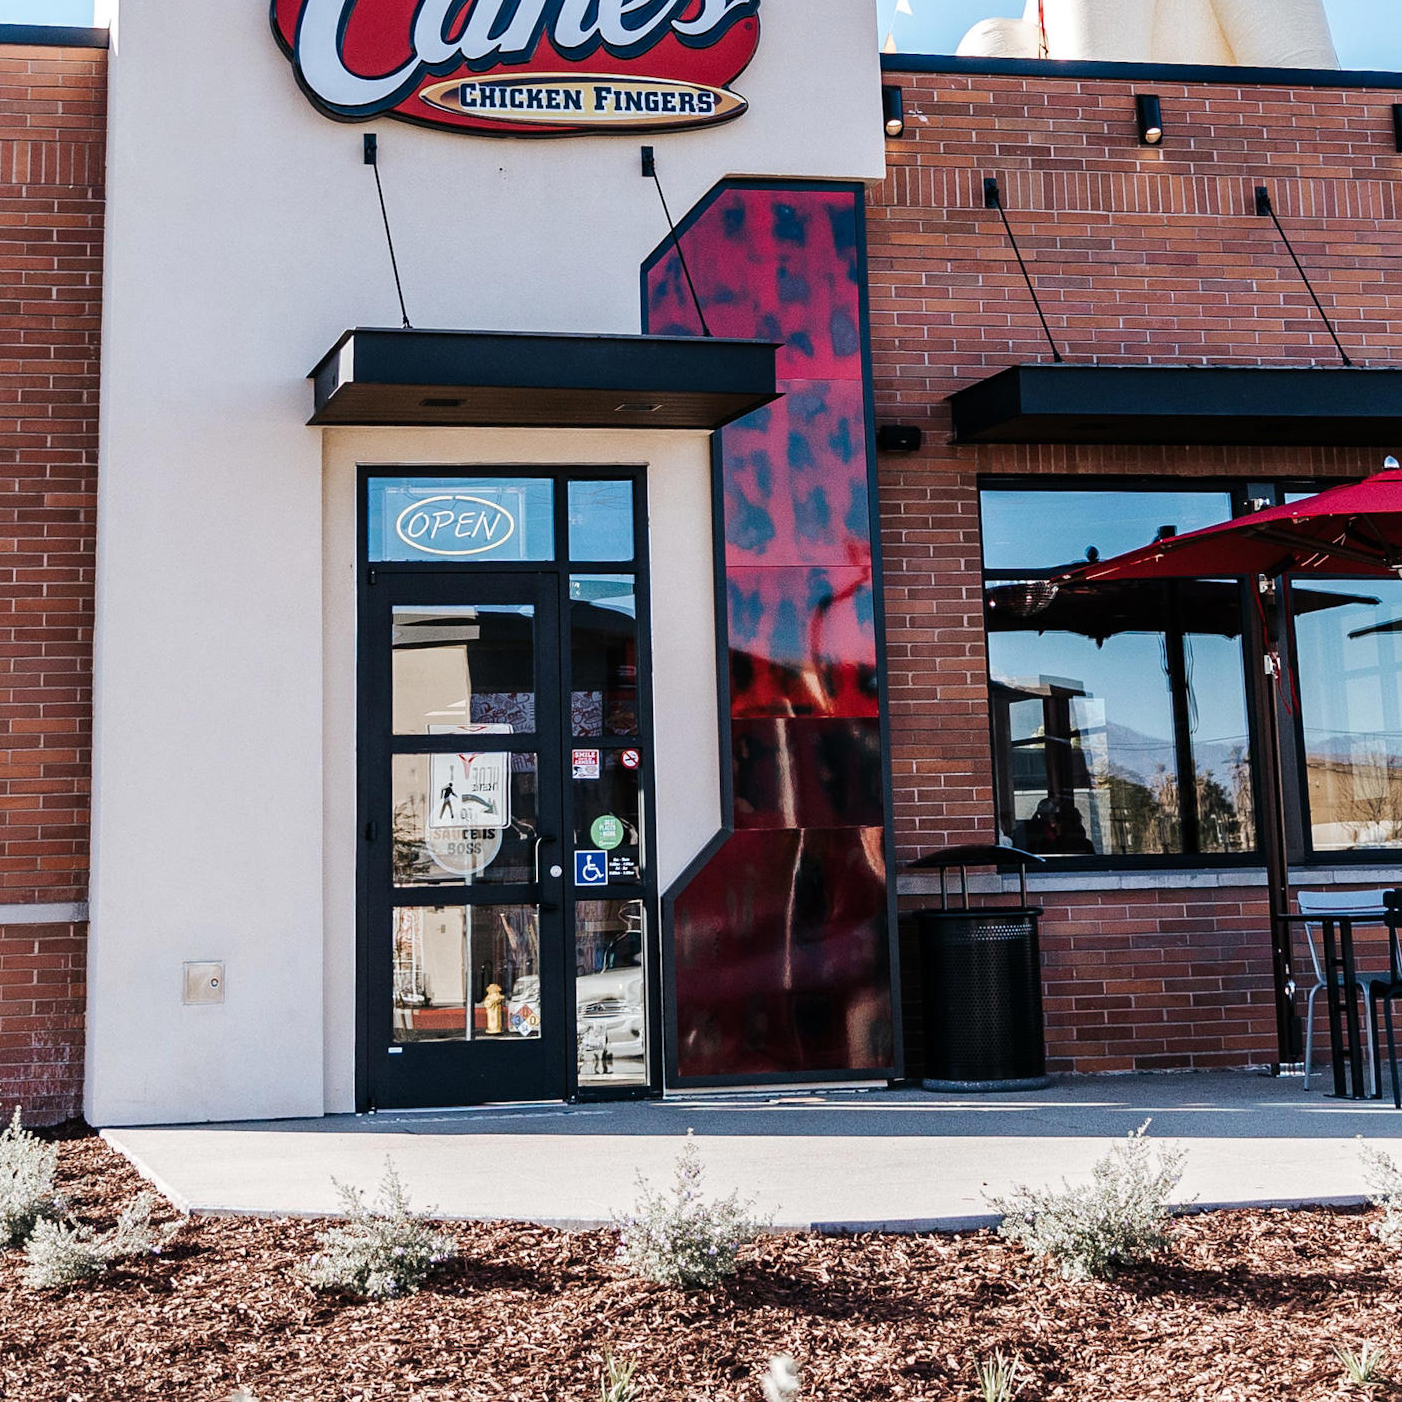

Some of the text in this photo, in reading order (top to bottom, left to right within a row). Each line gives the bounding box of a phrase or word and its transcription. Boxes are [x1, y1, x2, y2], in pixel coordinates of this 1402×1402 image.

[460, 82, 715, 115] CHICKEN FINGERS
[408, 510, 502, 540] OPEN
[446, 842, 482, 854] BOSS
